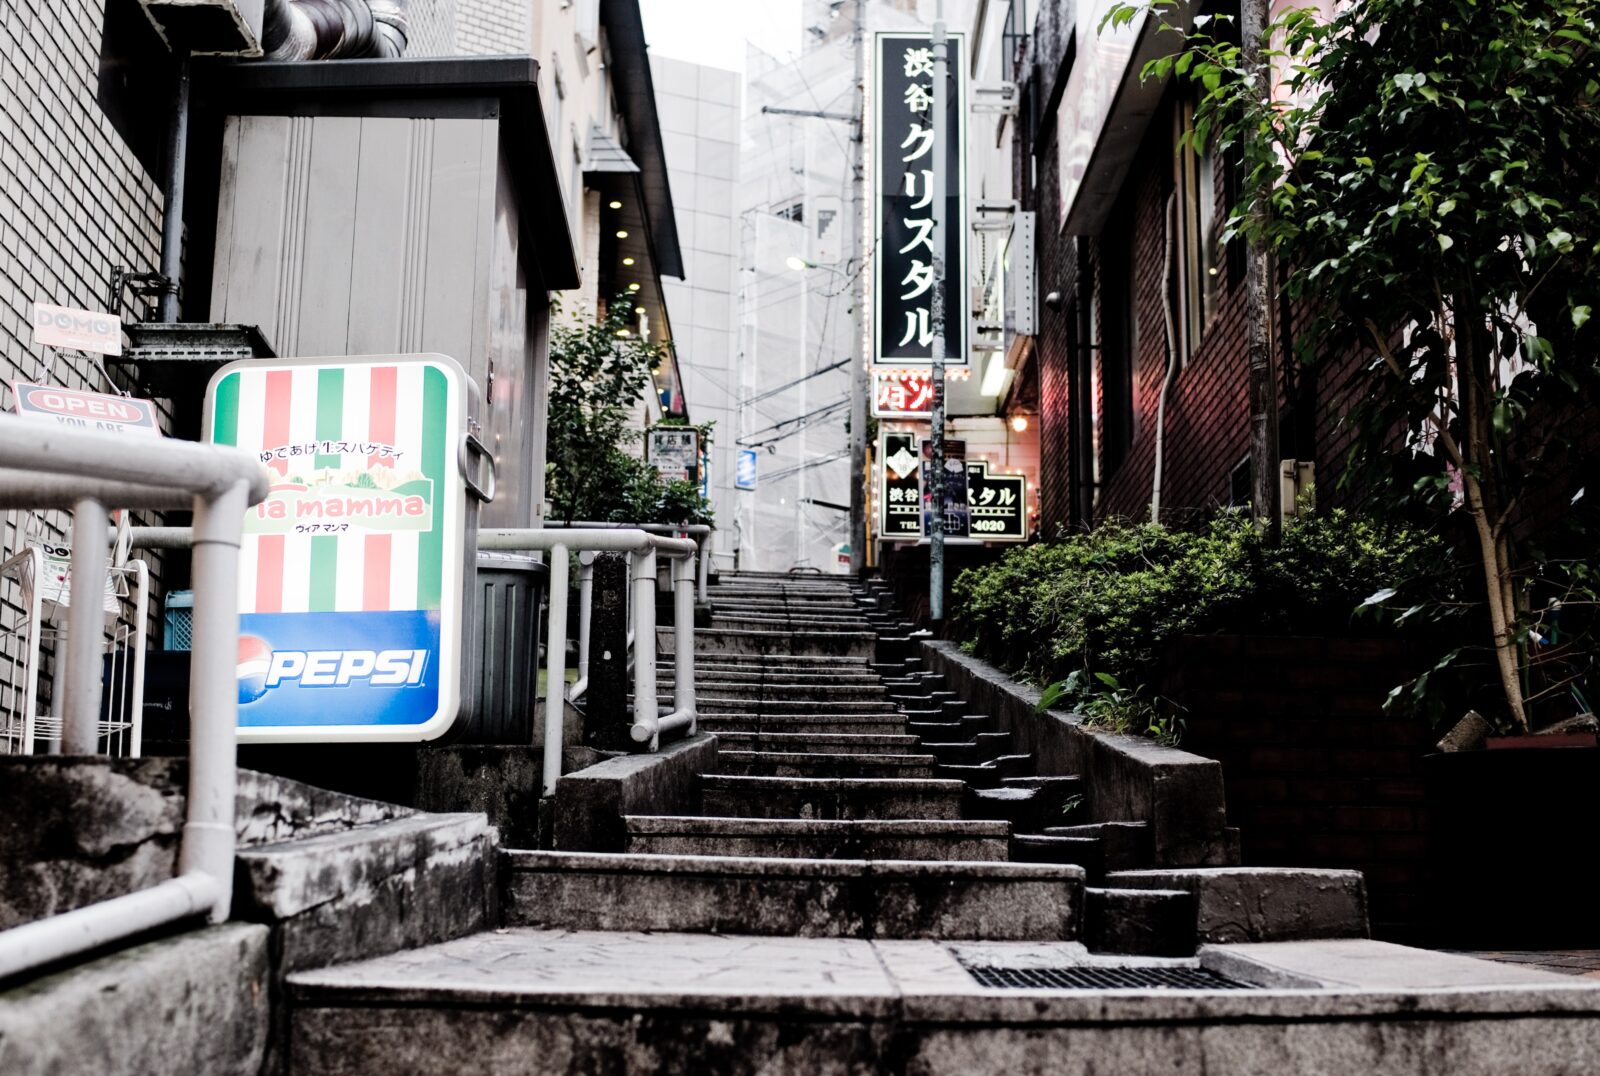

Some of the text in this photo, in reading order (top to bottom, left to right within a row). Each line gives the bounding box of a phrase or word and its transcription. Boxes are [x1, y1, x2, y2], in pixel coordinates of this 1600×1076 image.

[899, 47, 936, 348] 渋谷クリスタル
[43, 394, 129, 419] OPEN
[889, 487, 919, 502] 渋谷
[296, 497, 424, 518] mamma
[323, 523, 349, 532] マンマ
[265, 650, 427, 687] PEPSI
